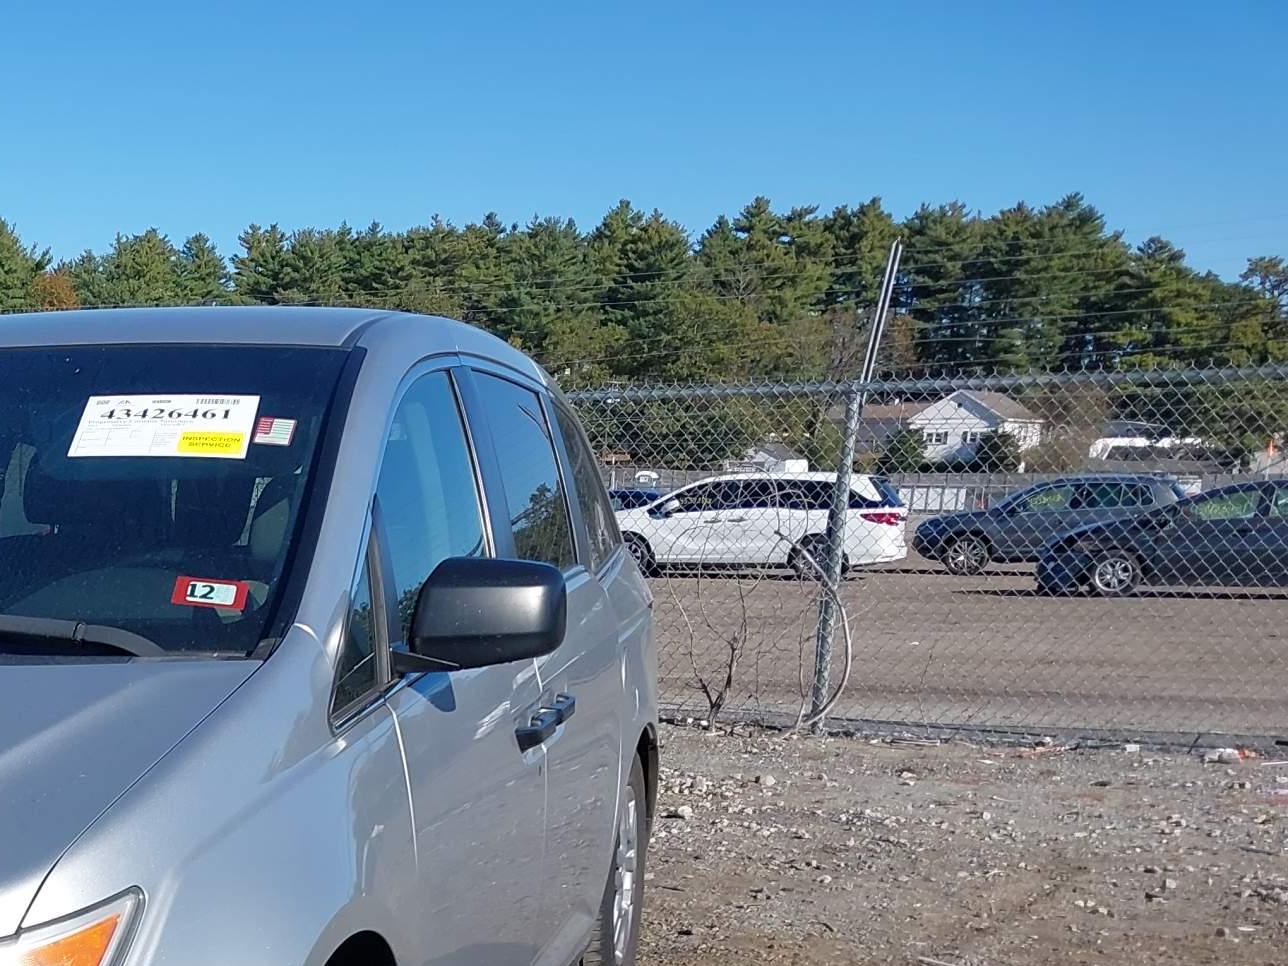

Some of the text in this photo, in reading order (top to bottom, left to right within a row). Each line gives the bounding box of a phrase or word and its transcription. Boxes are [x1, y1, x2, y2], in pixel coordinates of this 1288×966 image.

[100, 408, 232, 419] 43426461
[182, 435, 241, 443] INSPECTION
[186, 583, 216, 600] 12
